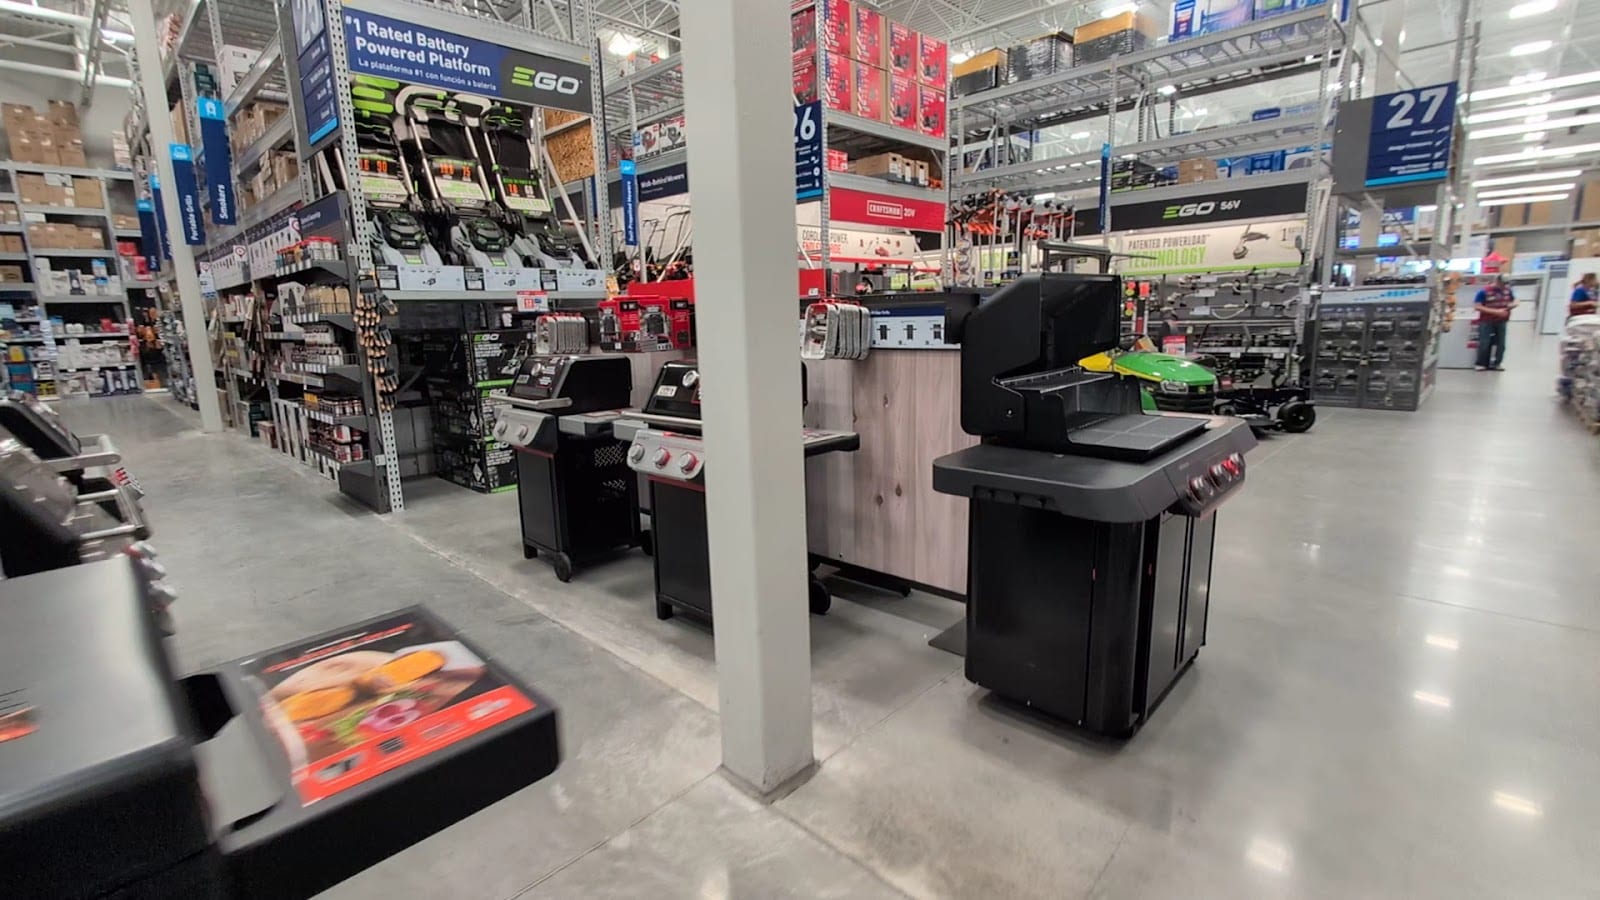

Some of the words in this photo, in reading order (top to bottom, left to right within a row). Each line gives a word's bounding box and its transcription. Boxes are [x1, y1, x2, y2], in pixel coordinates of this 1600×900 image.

[345, 15, 361, 33] #1
[366, 21, 413, 45] Rated
[416, 32, 469, 59] Battery
[355, 37, 425, 64] Powered
[429, 52, 491, 77] Platform
[358, 58, 369, 67] La
[370, 59, 413, 76] plataforma
[425, 72, 439, 80] con
[511, 66, 579, 95] EGO
[1386, 86, 1449, 130] 27
[185, 194, 194, 213] Grills
[219, 184, 228, 220] Smokers
[869, 203, 901, 217] CRAFTSMAN
[903, 207, 916, 217] 20V
[1163, 202, 1215, 219] EGO
[1219, 200, 1241, 211] 56V
[188, 213, 199, 241] Portable
[1128, 238, 1161, 250] PATENTED
[1128, 245, 1207, 269] TECHNOLOGY
[474, 333, 500, 341] EGO
[486, 441, 509, 450] EGO
